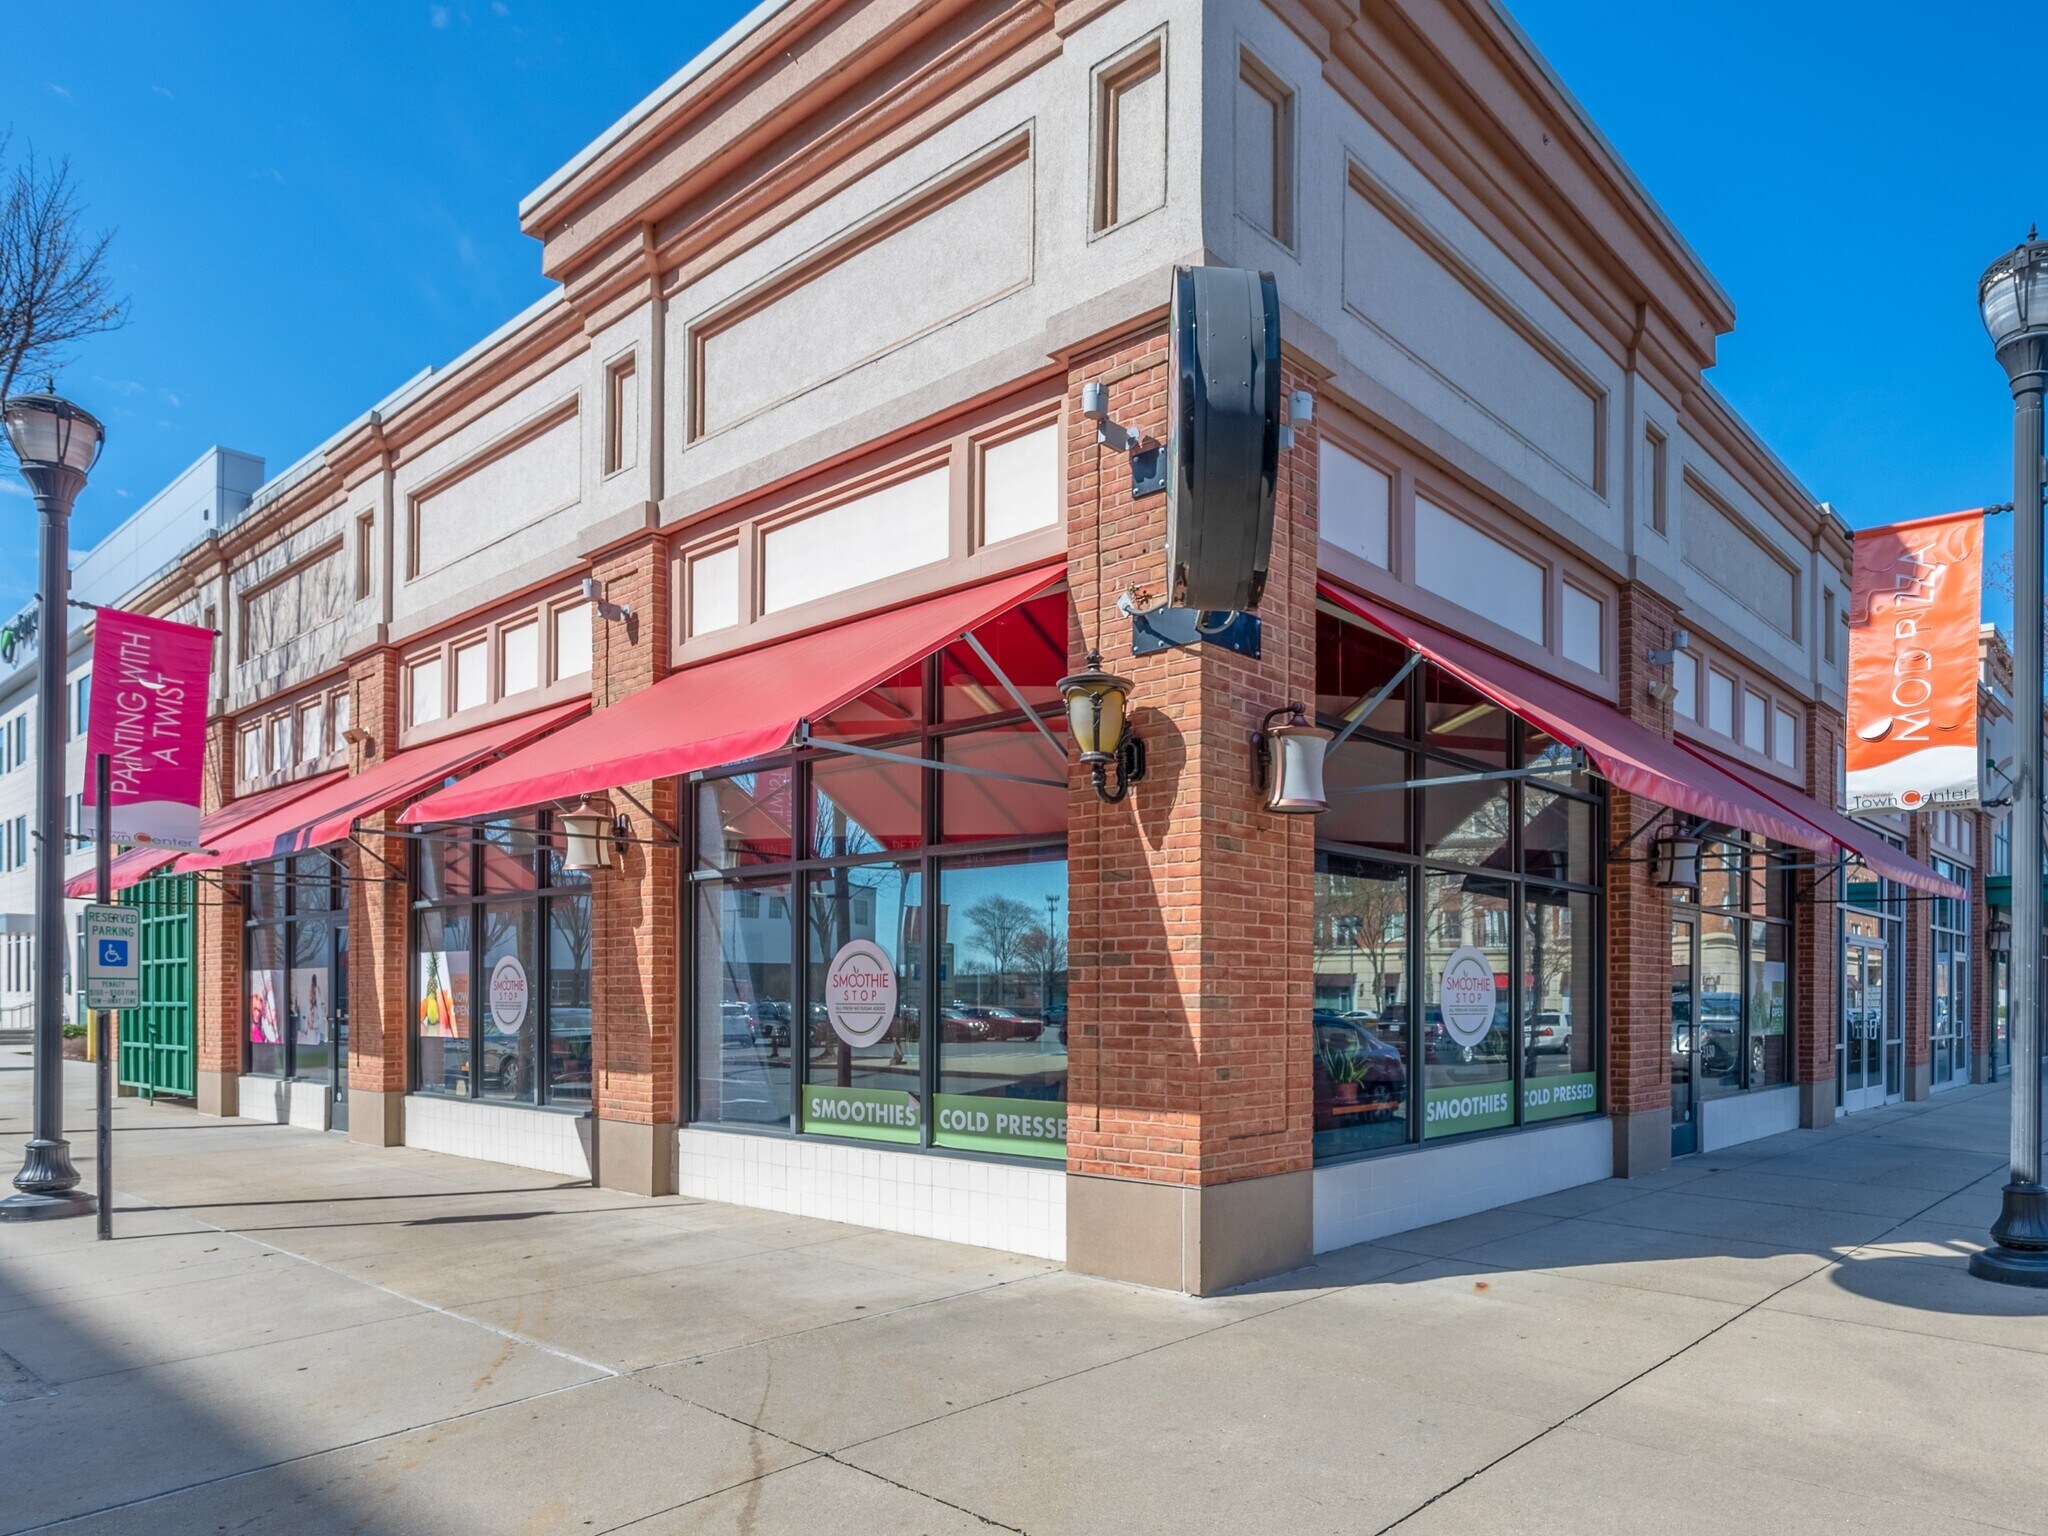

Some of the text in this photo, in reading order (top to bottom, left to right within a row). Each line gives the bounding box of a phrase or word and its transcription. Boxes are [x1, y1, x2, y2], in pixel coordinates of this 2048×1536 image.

[118, 631, 151, 684] WITH
[1891, 649, 1932, 741] MOD
[151, 672, 185, 766] A TWIST
[110, 691, 148, 795] PAINTING
[1853, 788, 1971, 809] Town Center
[88, 828, 131, 841] Twn
[89, 911, 138, 924] RESERVED
[92, 925, 135, 937] PARKING
[101, 980, 125, 988] PENALTY
[493, 979, 524, 991] SMOOTHIE
[832, 973, 889, 988] SMOOTHIE
[1446, 976, 1491, 991] SMOOTHIE
[499, 991, 518, 1001] STOP
[843, 989, 877, 1001] STOP
[1455, 992, 1482, 1004] STOP
[1553, 1083, 1594, 1103] PRESSED
[811, 1097, 916, 1127] SMOOTHIES
[1426, 1093, 1508, 1122] SMOOTHIES
[939, 1108, 990, 1132] COLD
